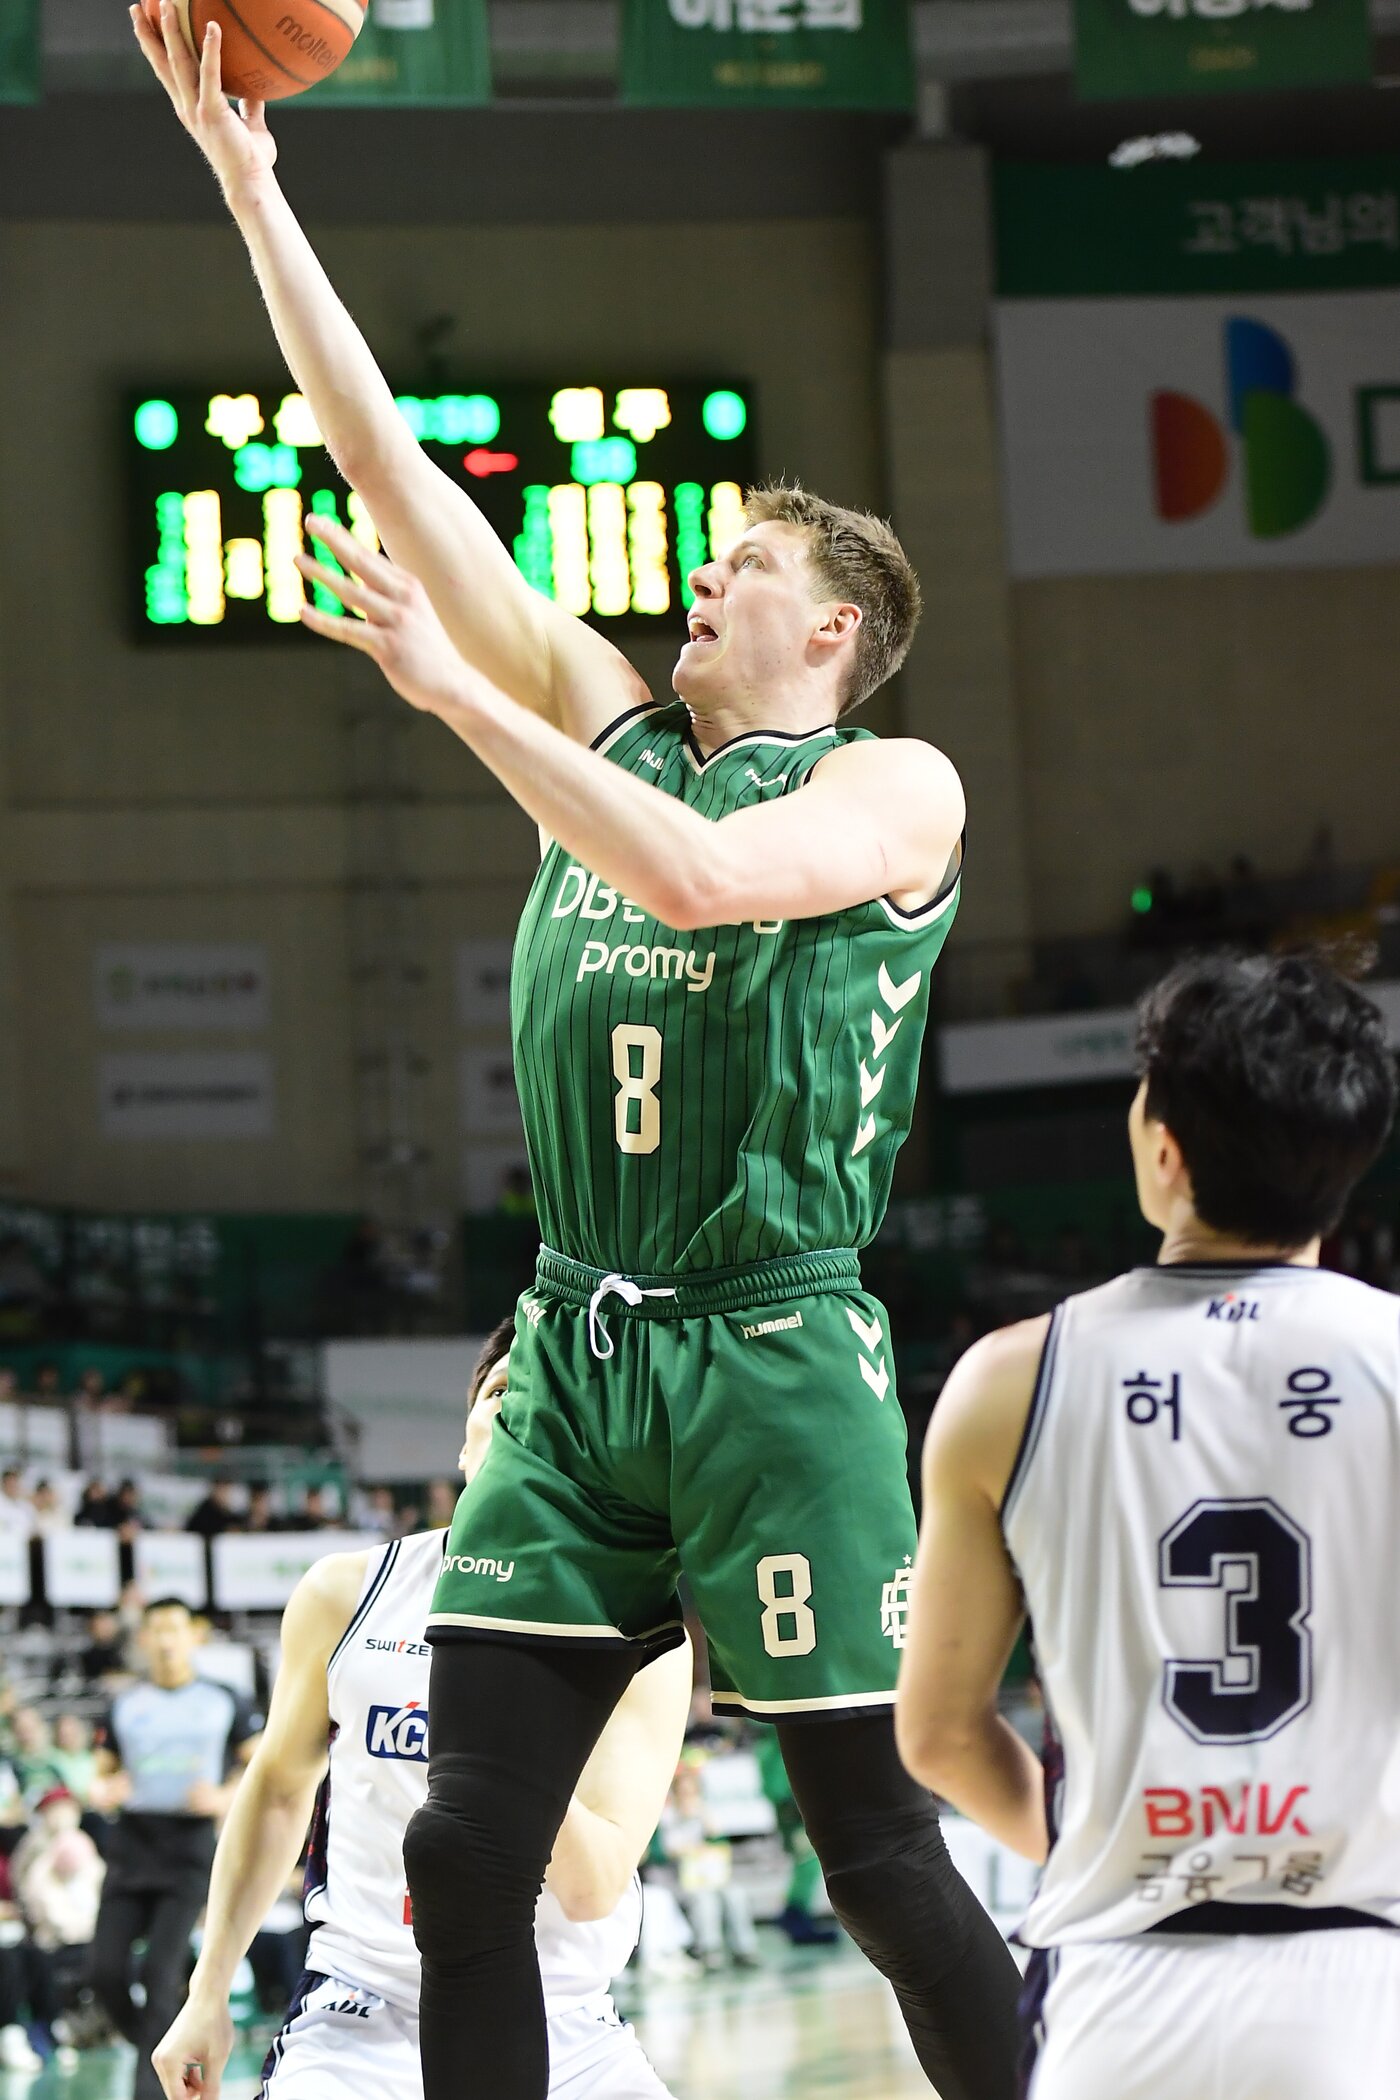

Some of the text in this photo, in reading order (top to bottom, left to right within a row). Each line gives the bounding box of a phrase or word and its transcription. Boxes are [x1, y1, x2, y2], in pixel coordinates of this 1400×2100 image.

[274, 14, 339, 70] molten
[576, 941, 716, 992] promy
[611, 1022, 663, 1155] 8
[740, 1310, 804, 1340] hummel
[440, 1555, 515, 1582] promy
[756, 1552, 818, 1659] 8
[1158, 1496, 1312, 1746] 3
[365, 1638, 431, 1656] SWItZE
[370, 1702, 428, 1756] KC
[1143, 1783, 1310, 1838] BNK
